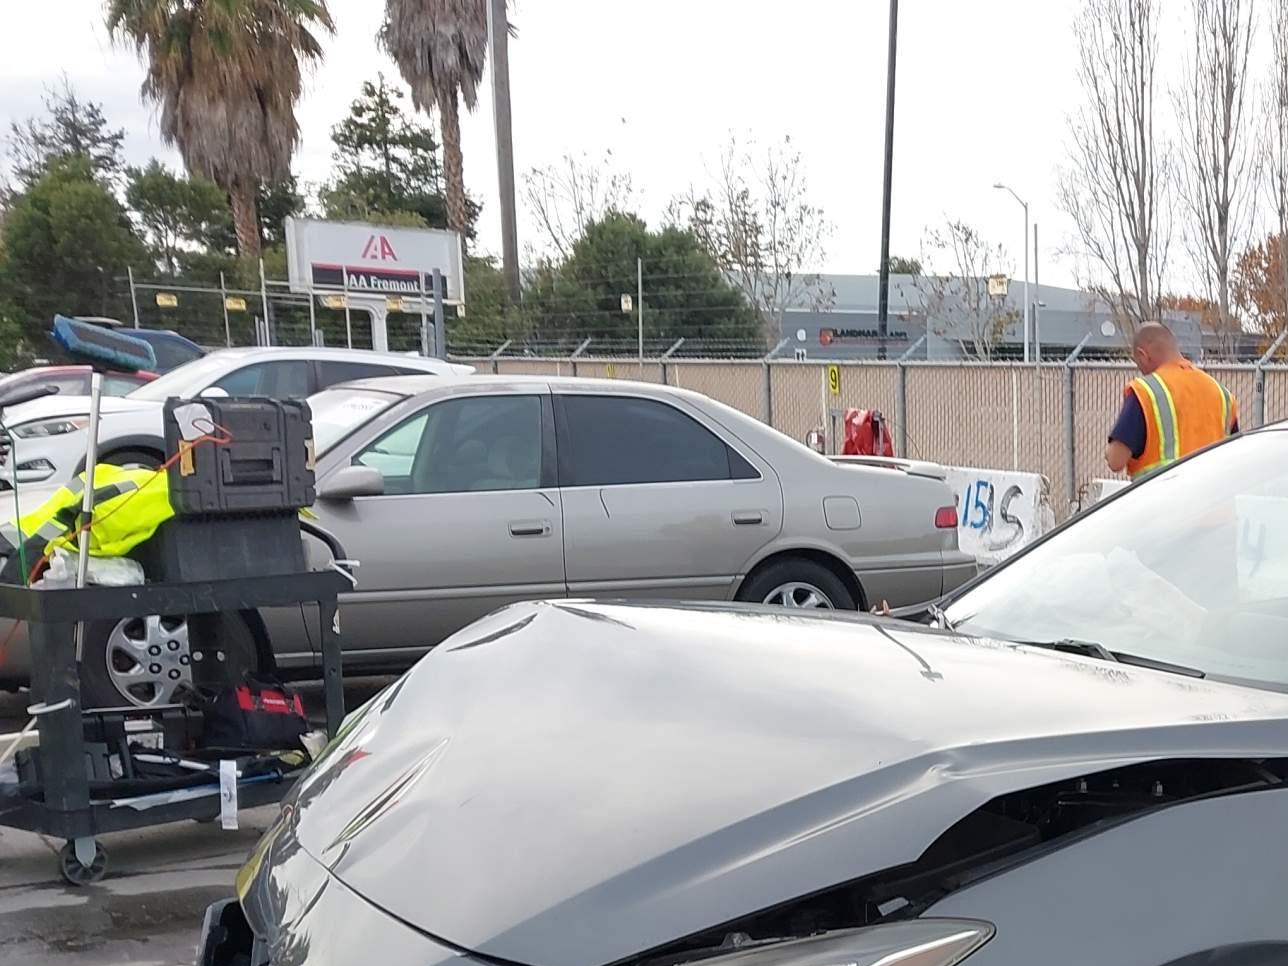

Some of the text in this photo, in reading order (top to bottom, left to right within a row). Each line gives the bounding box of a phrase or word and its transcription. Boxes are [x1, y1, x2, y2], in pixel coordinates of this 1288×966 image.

[345, 274, 368, 288] AA
[832, 328, 886, 337] LANDMAR
[830, 369, 838, 390] 9
